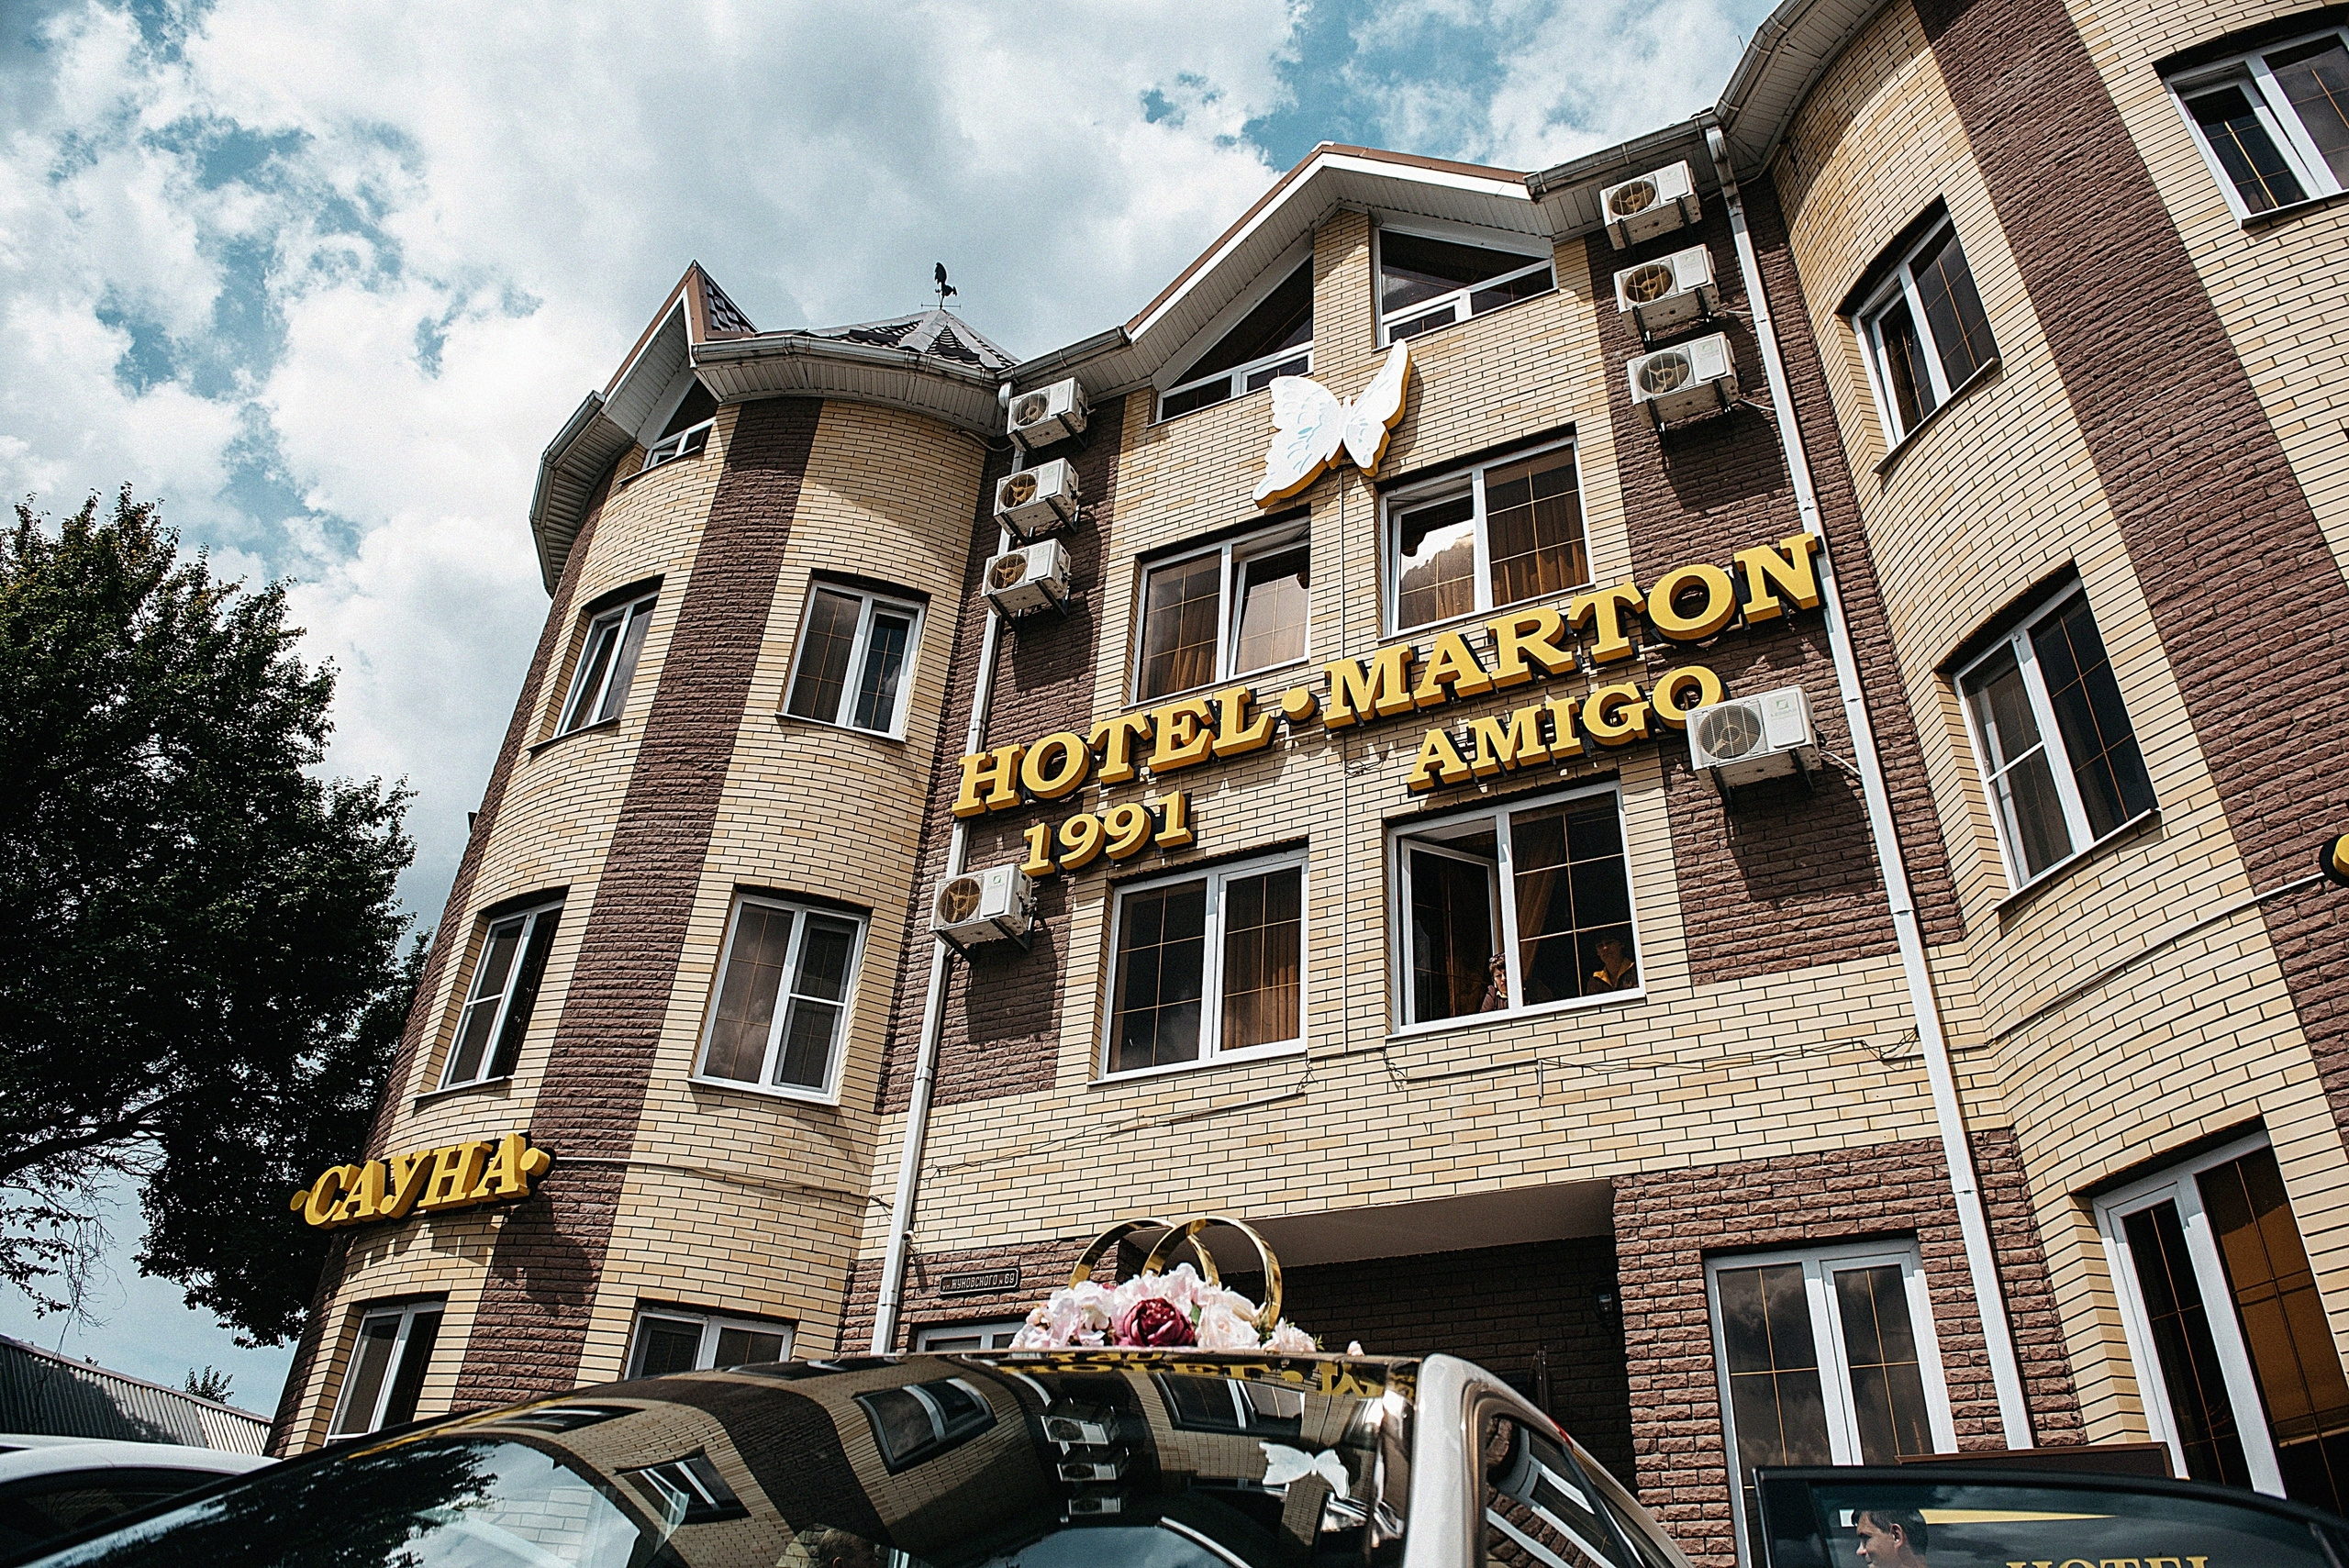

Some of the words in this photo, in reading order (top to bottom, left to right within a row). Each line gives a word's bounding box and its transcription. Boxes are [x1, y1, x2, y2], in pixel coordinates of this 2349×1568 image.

[952, 685, 1275, 817] HOTEL
[1323, 532, 1819, 729] MARTON
[1408, 665, 1725, 792] AMIGO
[1020, 790, 1194, 878] 1991
[304, 1132, 529, 1229] САУНА
[952, 1274, 998, 1290] ЖУКОВСКОГО
[1004, 1273, 1016, 1284] 69
